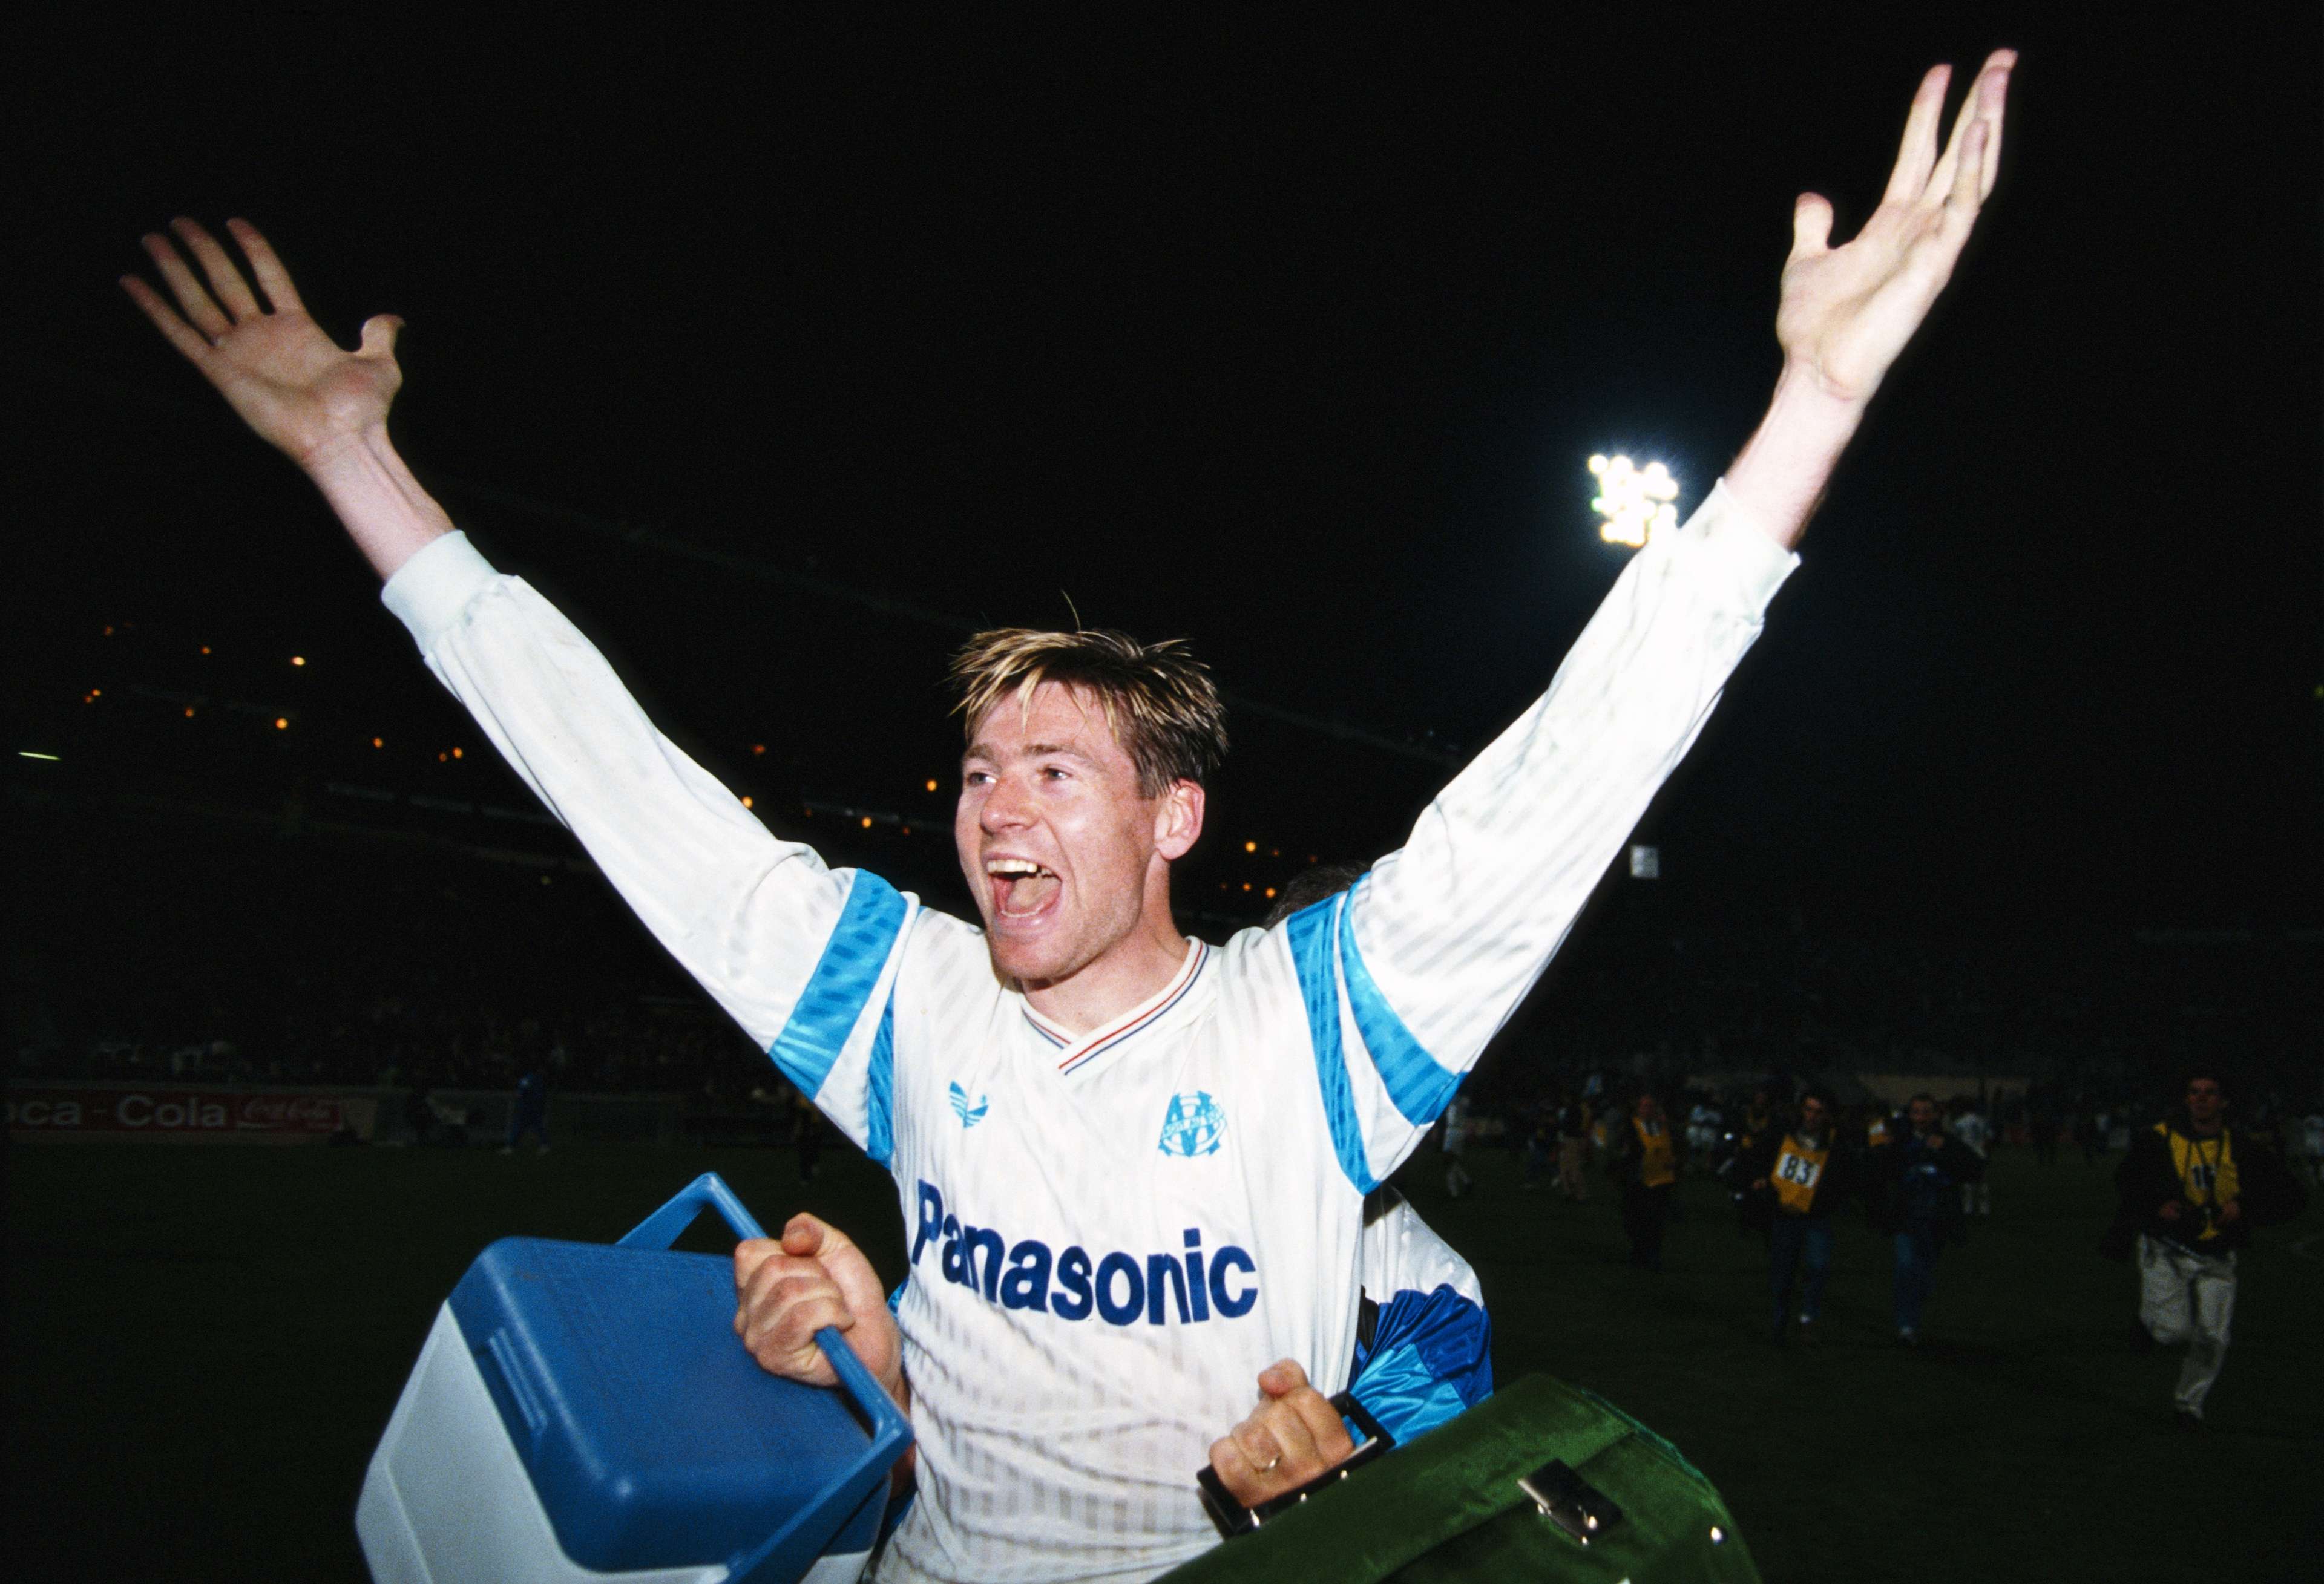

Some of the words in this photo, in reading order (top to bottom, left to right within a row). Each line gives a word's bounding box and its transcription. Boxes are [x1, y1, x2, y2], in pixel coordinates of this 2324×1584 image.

[117, 1094, 227, 1127] Cola
[1783, 1153, 1814, 1186] 83
[911, 1179, 1258, 1326] Panasonic
